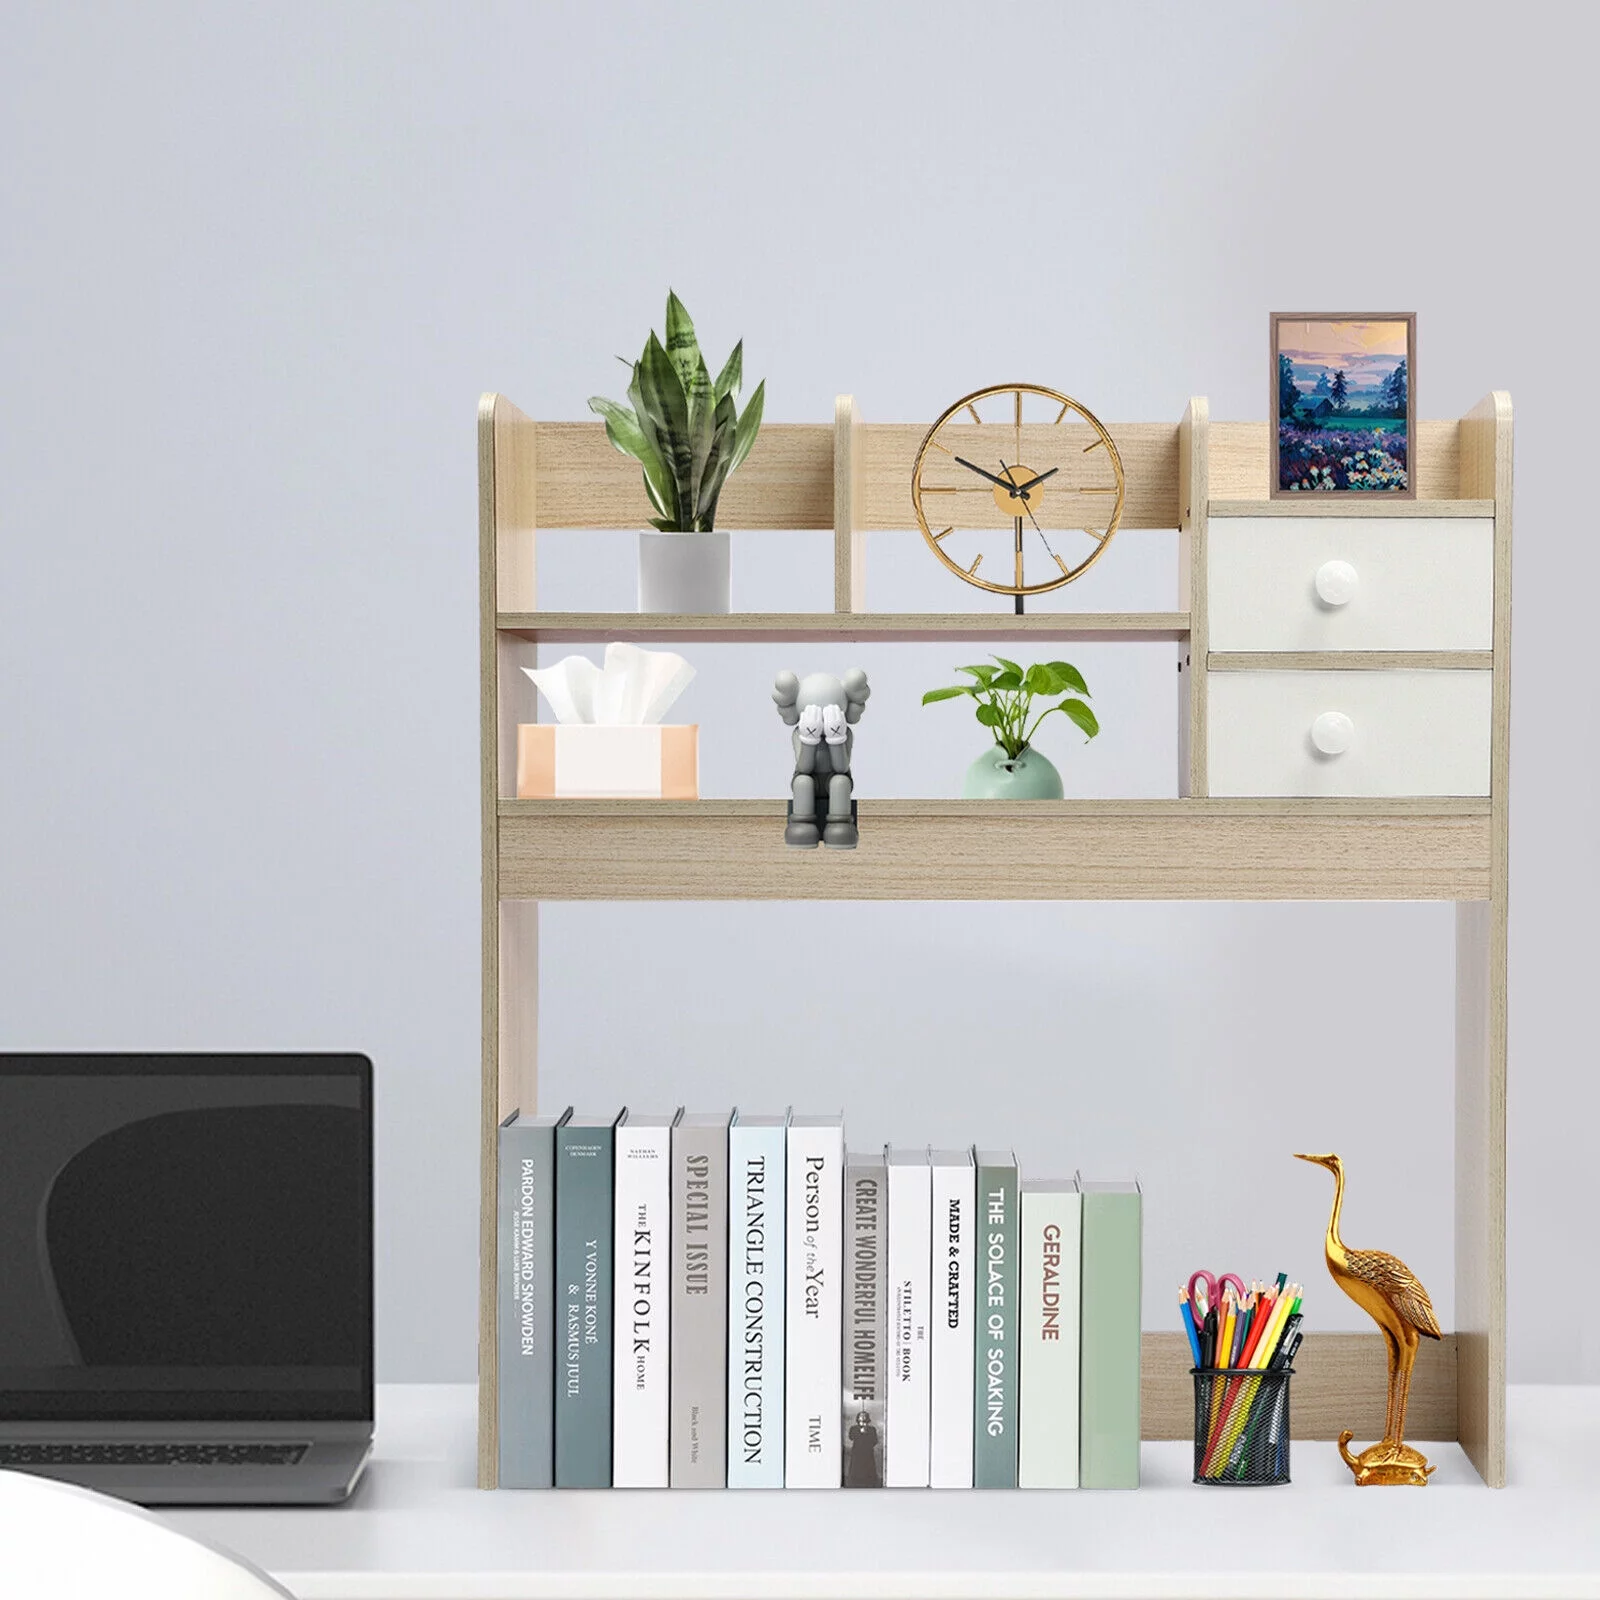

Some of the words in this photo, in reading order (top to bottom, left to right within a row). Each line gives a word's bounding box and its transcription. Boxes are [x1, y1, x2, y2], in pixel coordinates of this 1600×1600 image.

[521, 1158, 534, 1217] PARDON
[638, 1203, 646, 1228] THE
[686, 1155, 709, 1234] SPECIAL
[745, 1155, 765, 1275] TRIANGLE
[805, 1155, 825, 1233] Person
[855, 1179, 878, 1230] CREATE
[988, 1187, 1004, 1225] THE
[805, 1234, 817, 1250] of
[948, 1199, 961, 1244] MADE
[521, 1220, 534, 1280] EDWARD
[686, 1243, 709, 1295] ISSUE
[948, 1246, 960, 1257] &
[988, 1232, 1004, 1307] SOLACE
[568, 1284, 579, 1295] &
[633, 1229, 651, 1354] KINFOLK
[805, 1268, 825, 1319] Year
[854, 1235, 877, 1325] WONDERFUL
[948, 1261, 960, 1329] CRAFTED
[1042, 1224, 1061, 1341] GERALDINE
[521, 1283, 534, 1356] SNOWDEN
[568, 1304, 579, 1360] RASMUS
[585, 1305, 598, 1344] KONÉ
[903, 1280, 912, 1341] STILETTO
[988, 1314, 1004, 1341] OF
[566, 1362, 579, 1398] JUUL
[636, 1355, 645, 1391] HOME
[743, 1281, 765, 1465] CONSTRUCTION
[853, 1329, 876, 1401] HOMELIFE
[902, 1347, 911, 1383] BOOK
[987, 1348, 1004, 1437] SOAKING
[808, 1415, 822, 1454] TIME
